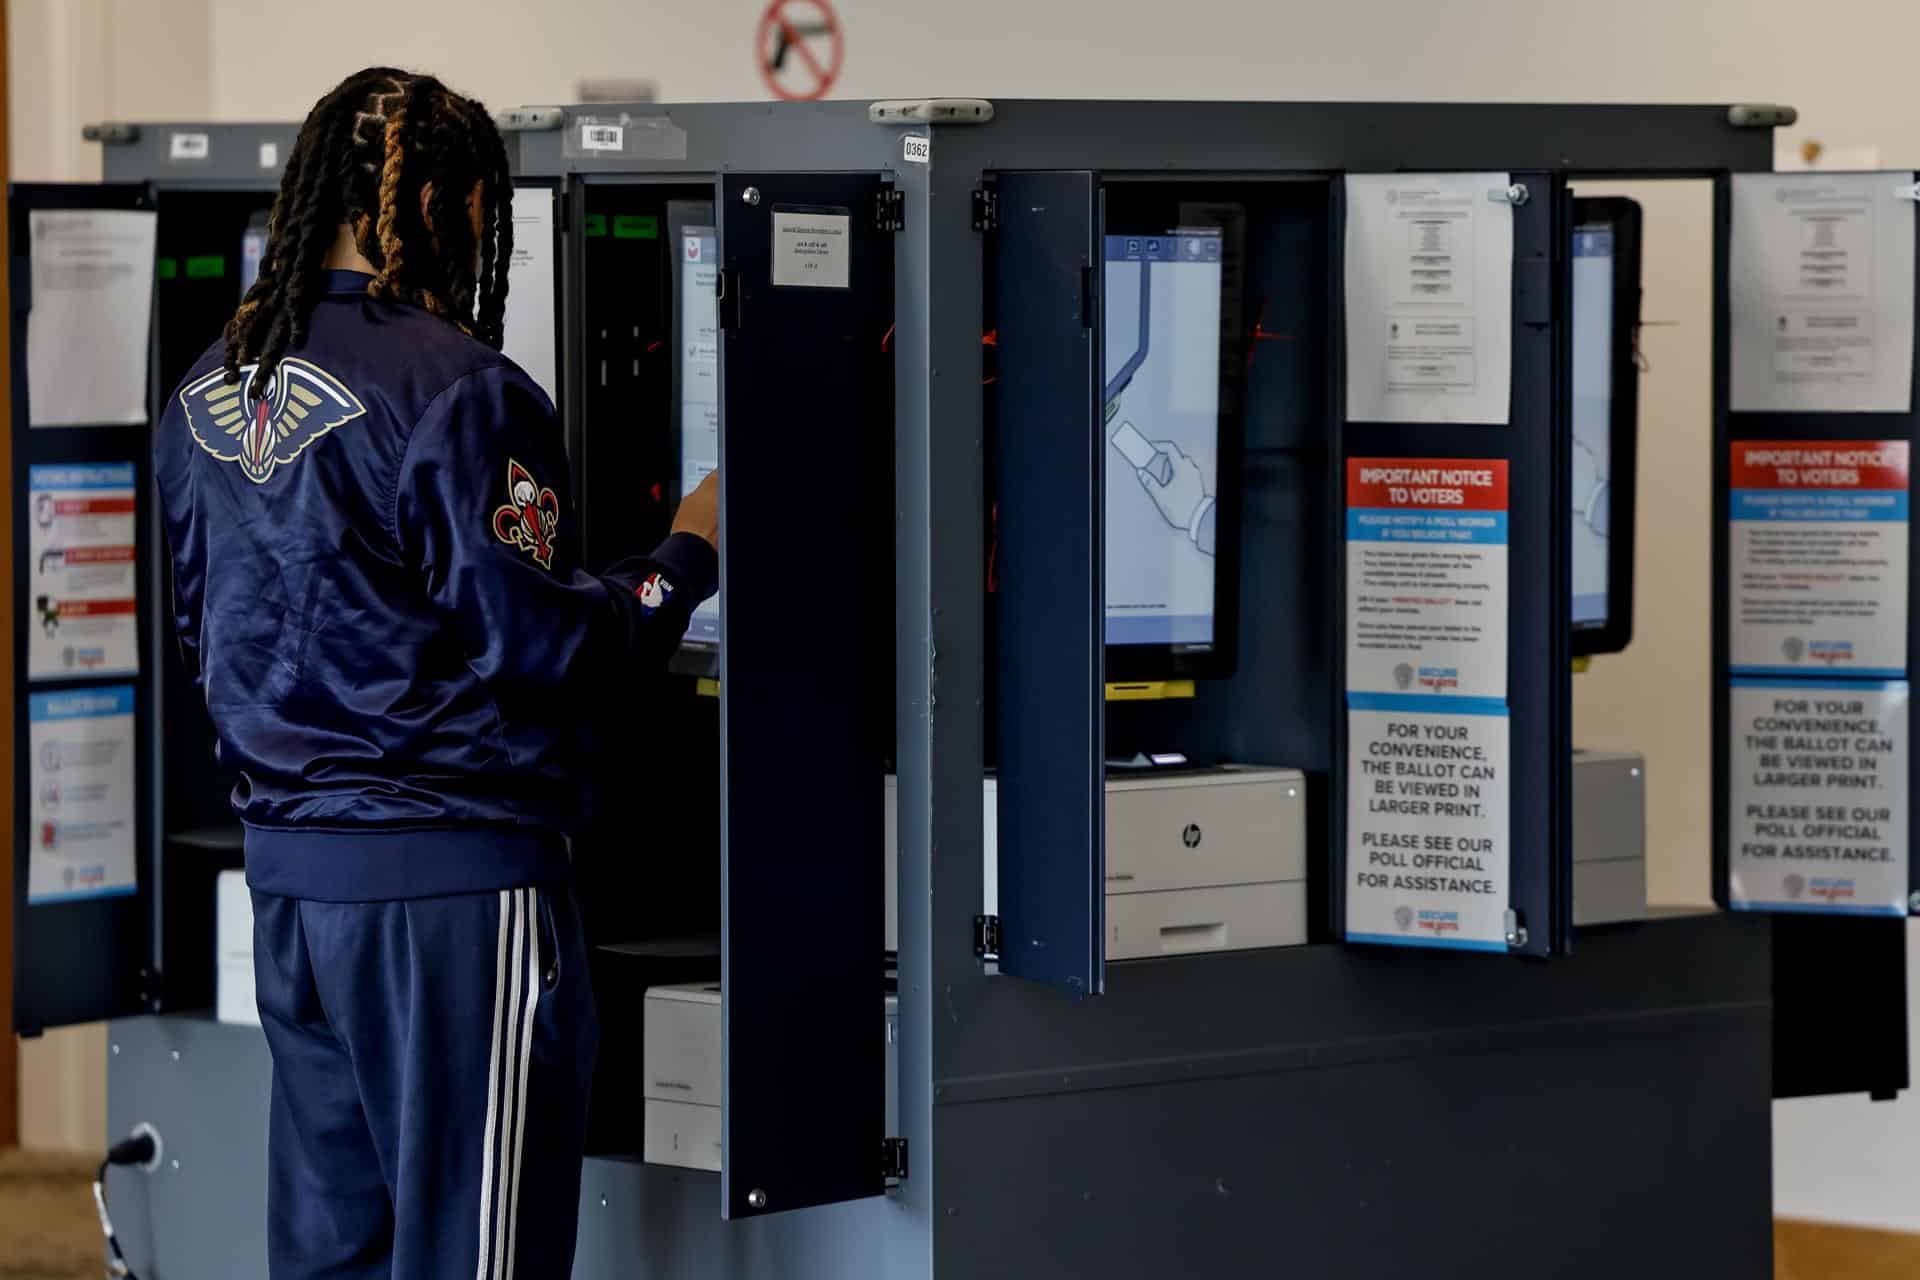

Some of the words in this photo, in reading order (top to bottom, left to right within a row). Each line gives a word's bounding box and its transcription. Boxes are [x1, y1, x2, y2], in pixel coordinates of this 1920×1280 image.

[907, 142, 926, 157] 0362
[1745, 449, 1832, 466] IMPORTANT
[1360, 468, 1439, 485] IMPORTANT
[1441, 469, 1494, 486] NOTICE
[1776, 468, 1798, 484] TO
[1801, 468, 1860, 485] VOTERS
[1389, 487, 1408, 503] TO
[1411, 488, 1465, 505] VOTERS
[1774, 699, 1808, 714] FOR
[1814, 701, 1864, 715] YOUR
[1387, 723, 1419, 738] FOR
[1424, 725, 1469, 740] YOUR
[1369, 742, 1487, 761] CONVENIENCE,
[1744, 735, 1778, 750] THE
[1783, 737, 1850, 752] BALLOT
[1854, 738, 1893, 753] CAN
[1361, 760, 1391, 775] THE
[1395, 761, 1456, 778] BALLOT
[1459, 765, 1495, 780] CAN
[1760, 754, 1782, 768] BE
[1786, 755, 1854, 769] VIEWED
[1859, 756, 1878, 770] IN
[1375, 779, 1394, 794] BE
[1399, 781, 1459, 797] VIEWED
[1464, 784, 1481, 798] IN
[1754, 772, 1822, 787] LARGER
[1826, 774, 1883, 789] PRINT.
[1369, 800, 1431, 816] LARGER
[1434, 802, 1486, 819] PRINT.
[1746, 804, 1810, 819] PLEASE
[1815, 805, 1847, 820] SEE
[1851, 807, 1891, 822] OUR
[1755, 822, 1797, 838] POLL
[1802, 823, 1881, 841] OFFICIAL
[1362, 832, 1419, 849] PLEASE
[1423, 835, 1453, 850] SEE
[1457, 837, 1493, 853] OUR
[1369, 851, 1408, 868] POLL
[1412, 854, 1485, 872] OFFICIAL
[1742, 844, 1777, 858] FOR
[1782, 845, 1896, 863] ASSISTANCE.
[1357, 872, 1389, 888] FOR
[1393, 875, 1497, 895] ASSISTANCE.
